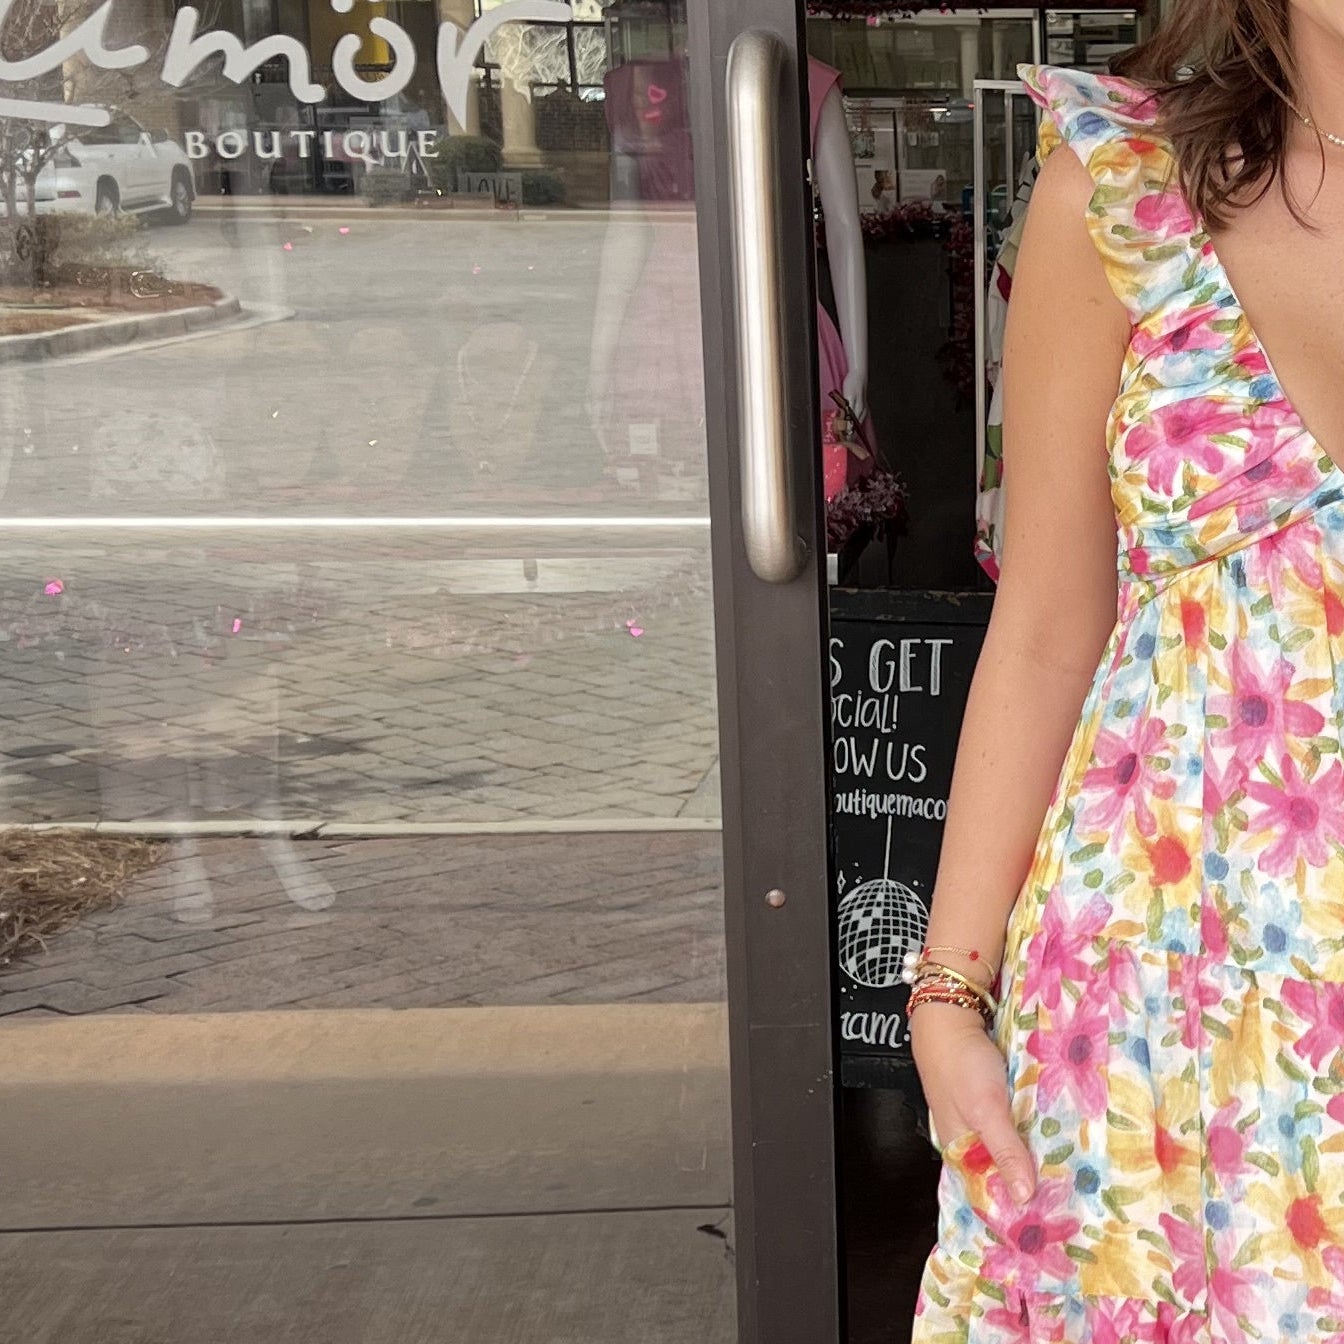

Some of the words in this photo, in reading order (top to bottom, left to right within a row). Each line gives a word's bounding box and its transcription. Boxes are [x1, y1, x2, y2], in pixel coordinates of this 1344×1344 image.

[185, 130, 440, 166] BOUTIQUE
[868, 638, 954, 697] GET
[886, 742, 928, 783] US
